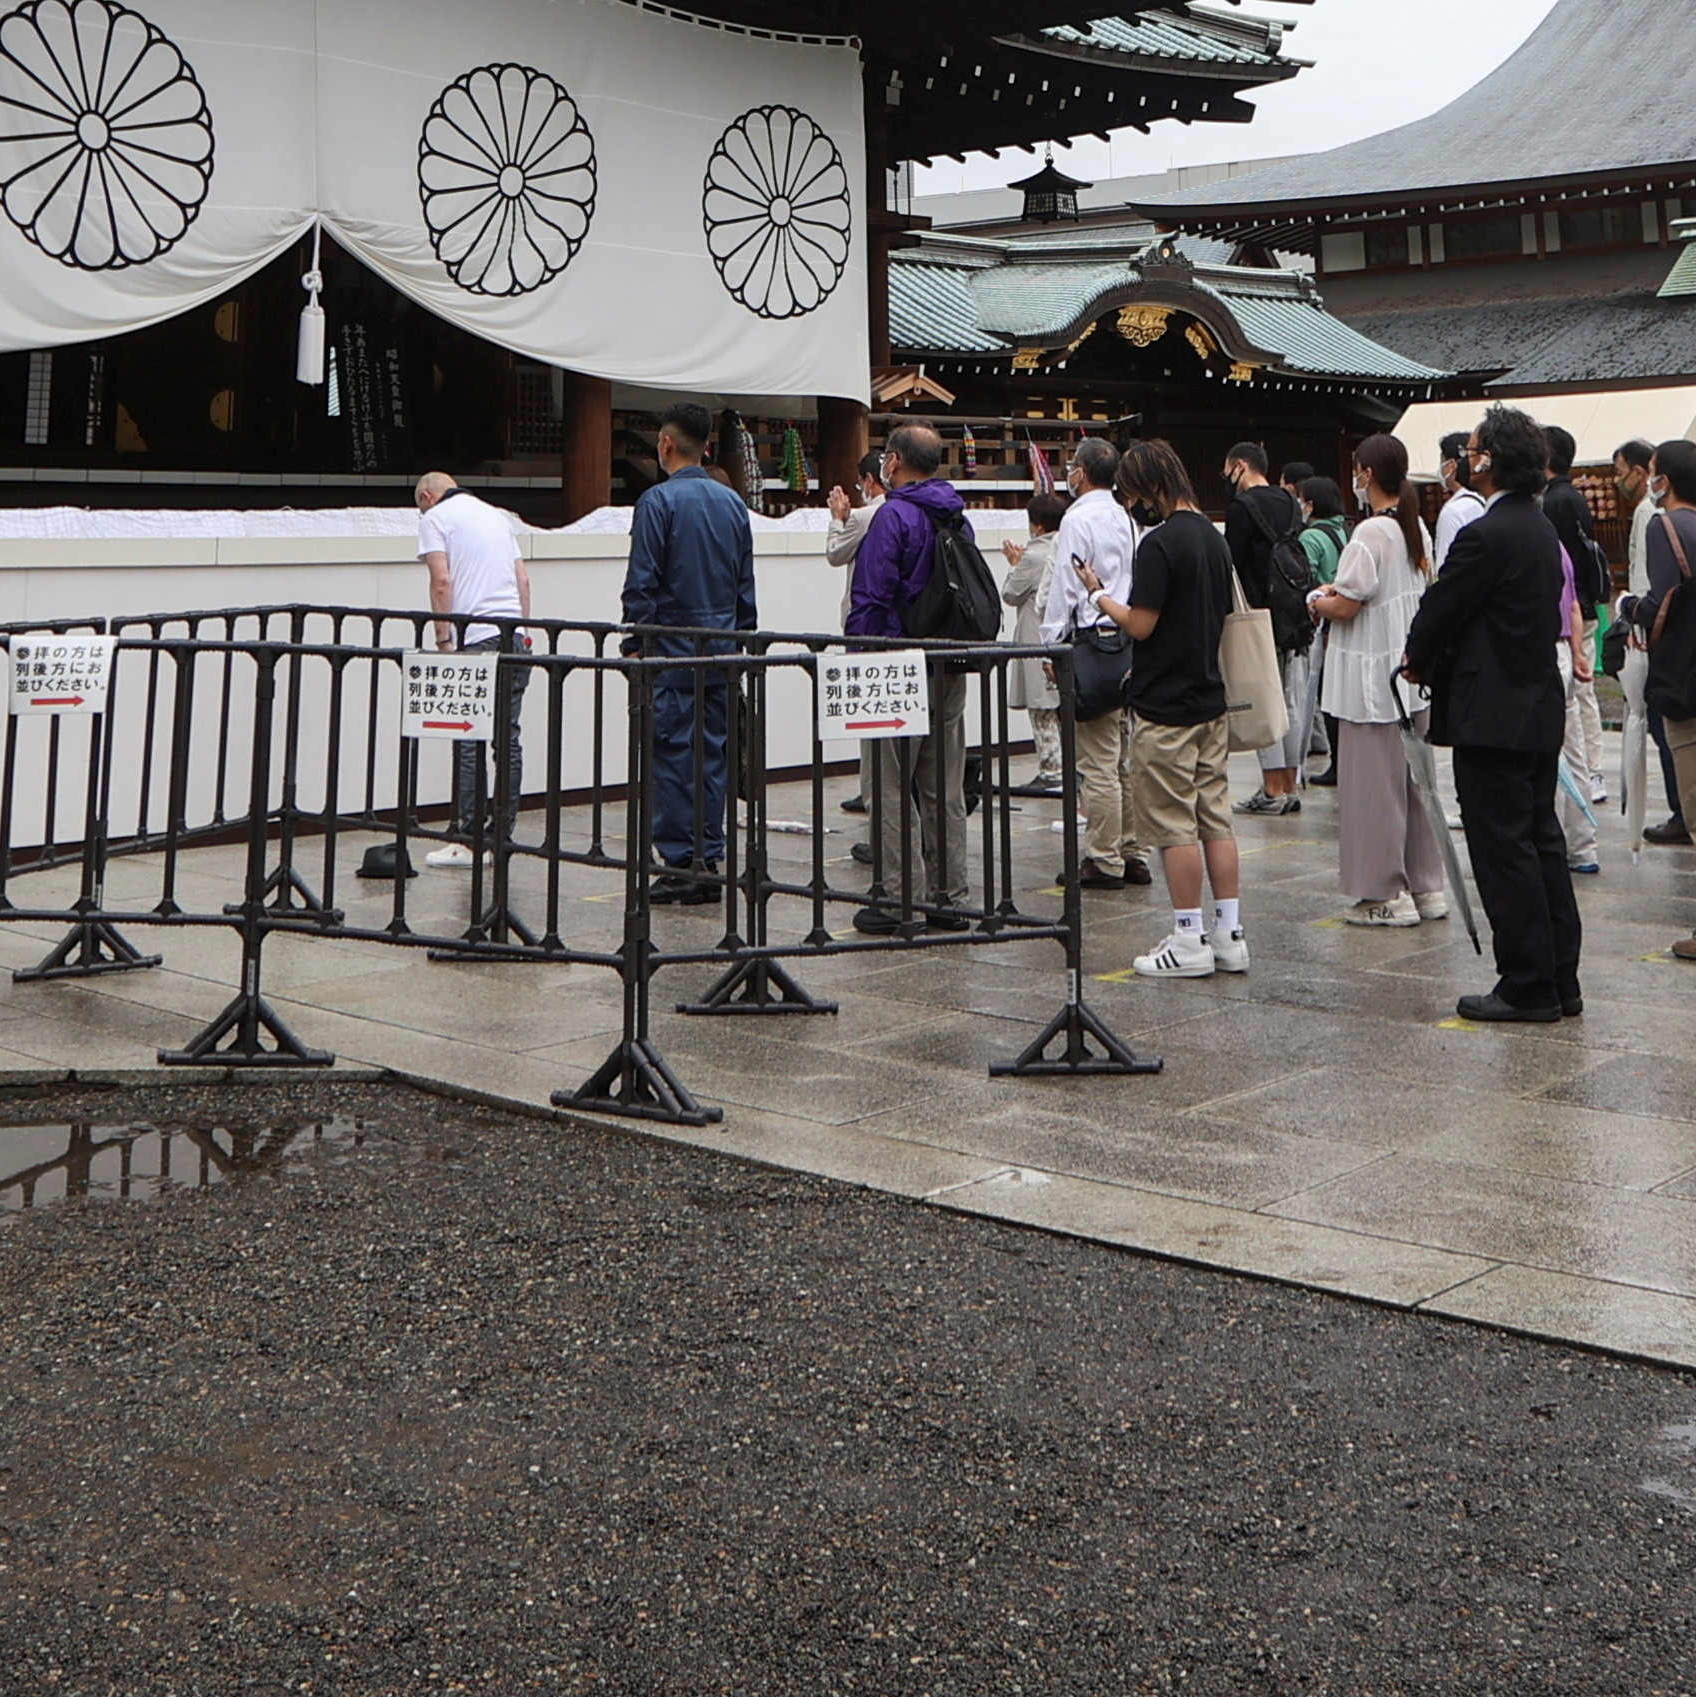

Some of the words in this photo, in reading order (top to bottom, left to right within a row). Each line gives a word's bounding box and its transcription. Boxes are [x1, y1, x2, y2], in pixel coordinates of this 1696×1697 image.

[16, 646, 104, 660] 参拝の方は
[15, 662, 103, 677] 列後方にお
[408, 665, 489, 682] 参拝の方は
[825, 664, 918, 682] 参拝の方は
[15, 678, 106, 693] 並びください。
[408, 682, 488, 699] 列後方にお
[825, 681, 919, 700] 列後方にお
[408, 699, 492, 718] 並びください。
[825, 699, 927, 718] 並びください。
